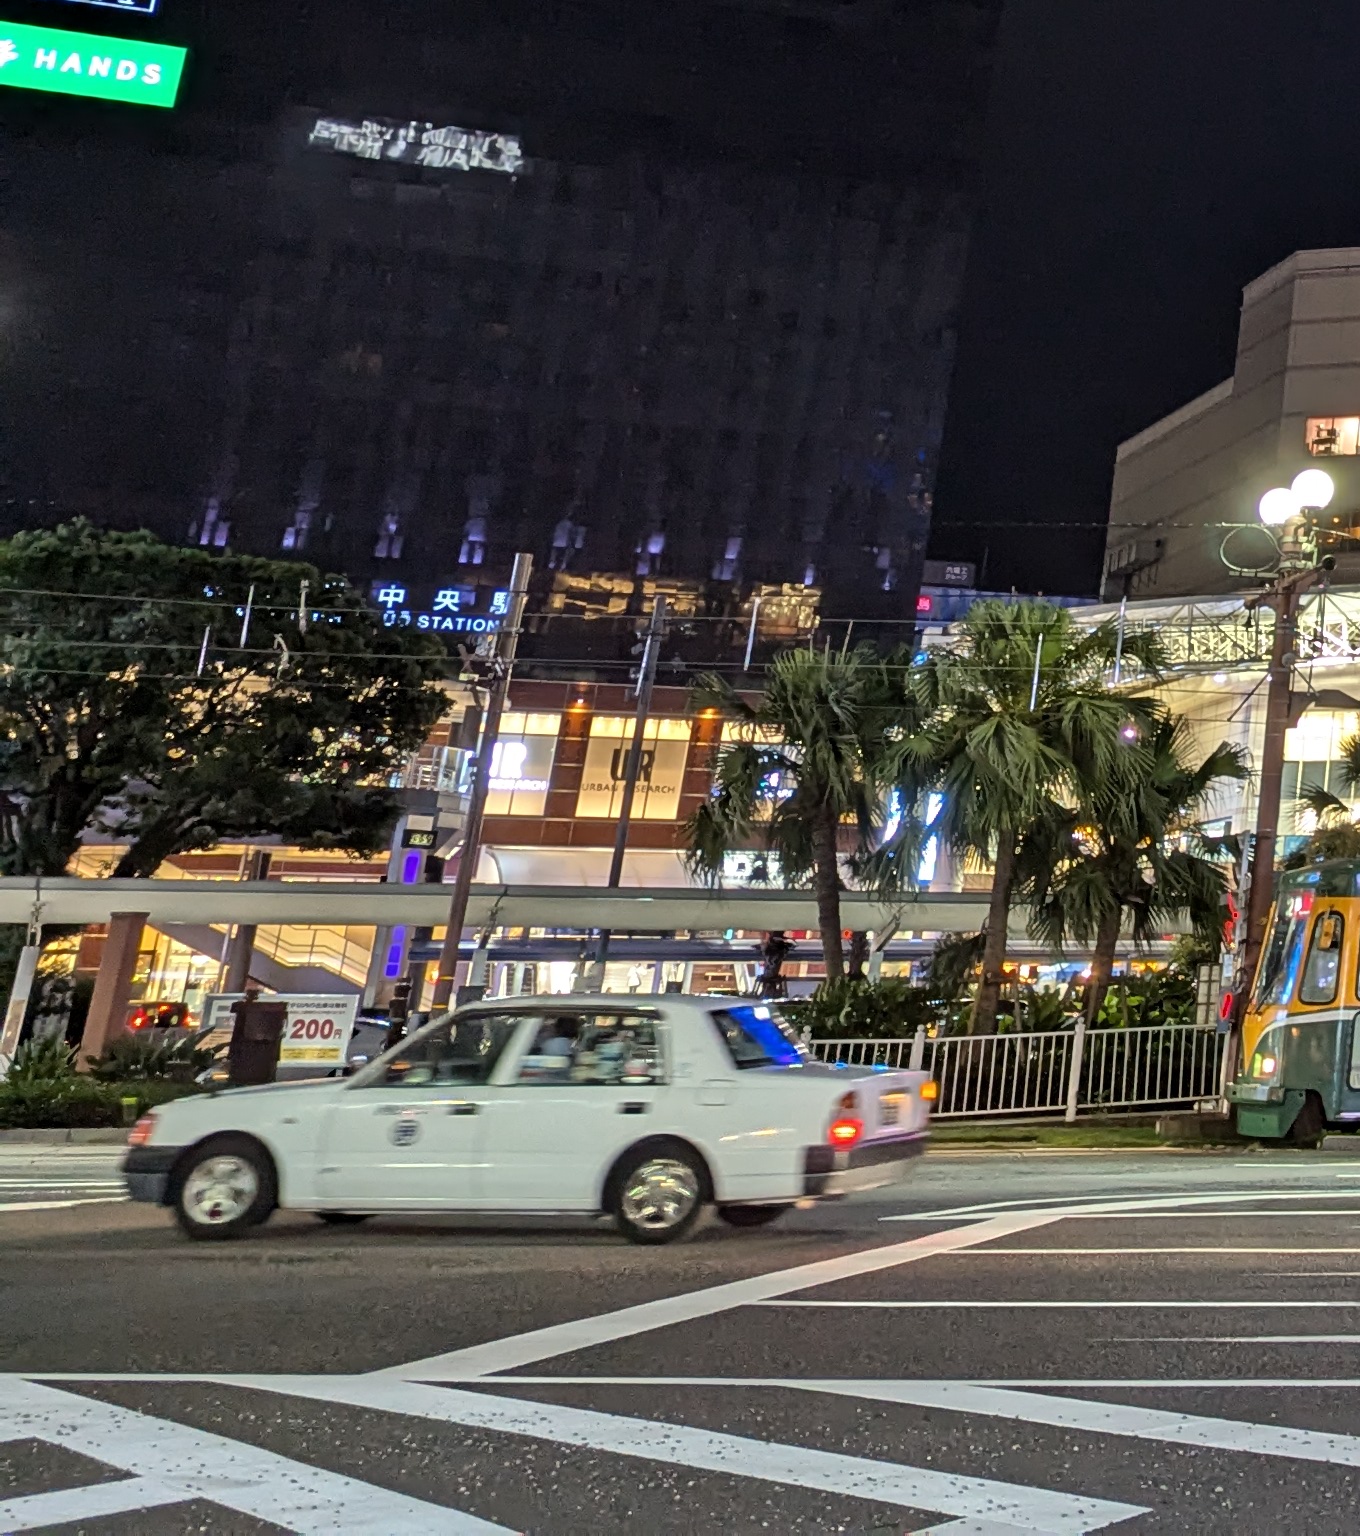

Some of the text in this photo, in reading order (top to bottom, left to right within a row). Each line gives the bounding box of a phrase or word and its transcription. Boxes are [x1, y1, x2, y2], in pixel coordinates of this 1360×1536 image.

[33, 47, 162, 85] HANDS
[416, 615, 500, 633] STATION
[581, 783, 618, 793] URBAN
[289, 1018, 343, 1040] 200円
